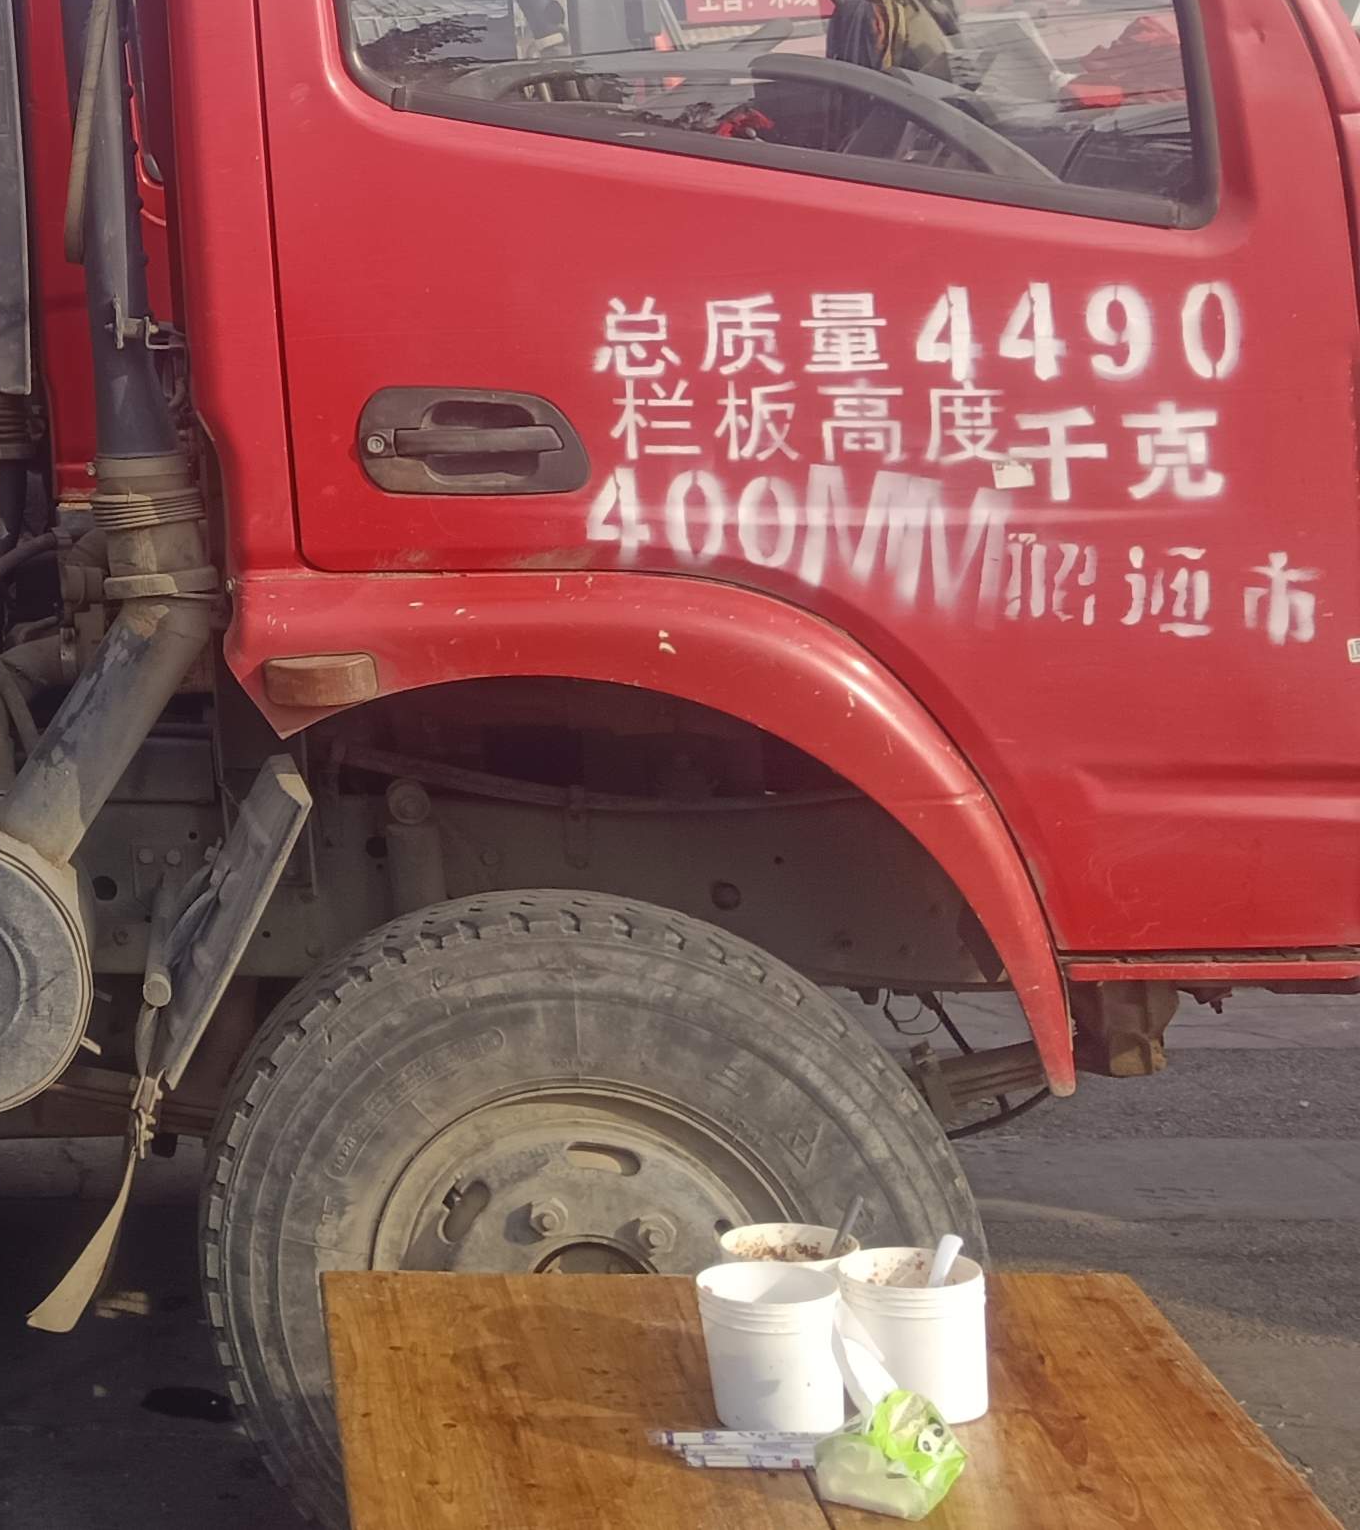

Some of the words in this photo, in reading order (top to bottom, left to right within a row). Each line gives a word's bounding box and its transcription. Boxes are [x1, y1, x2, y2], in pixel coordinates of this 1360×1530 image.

[611, 379, 1010, 465] 栏板高度
[1008, 401, 1226, 501] 千克
[586, 465, 1013, 627] 400MM
